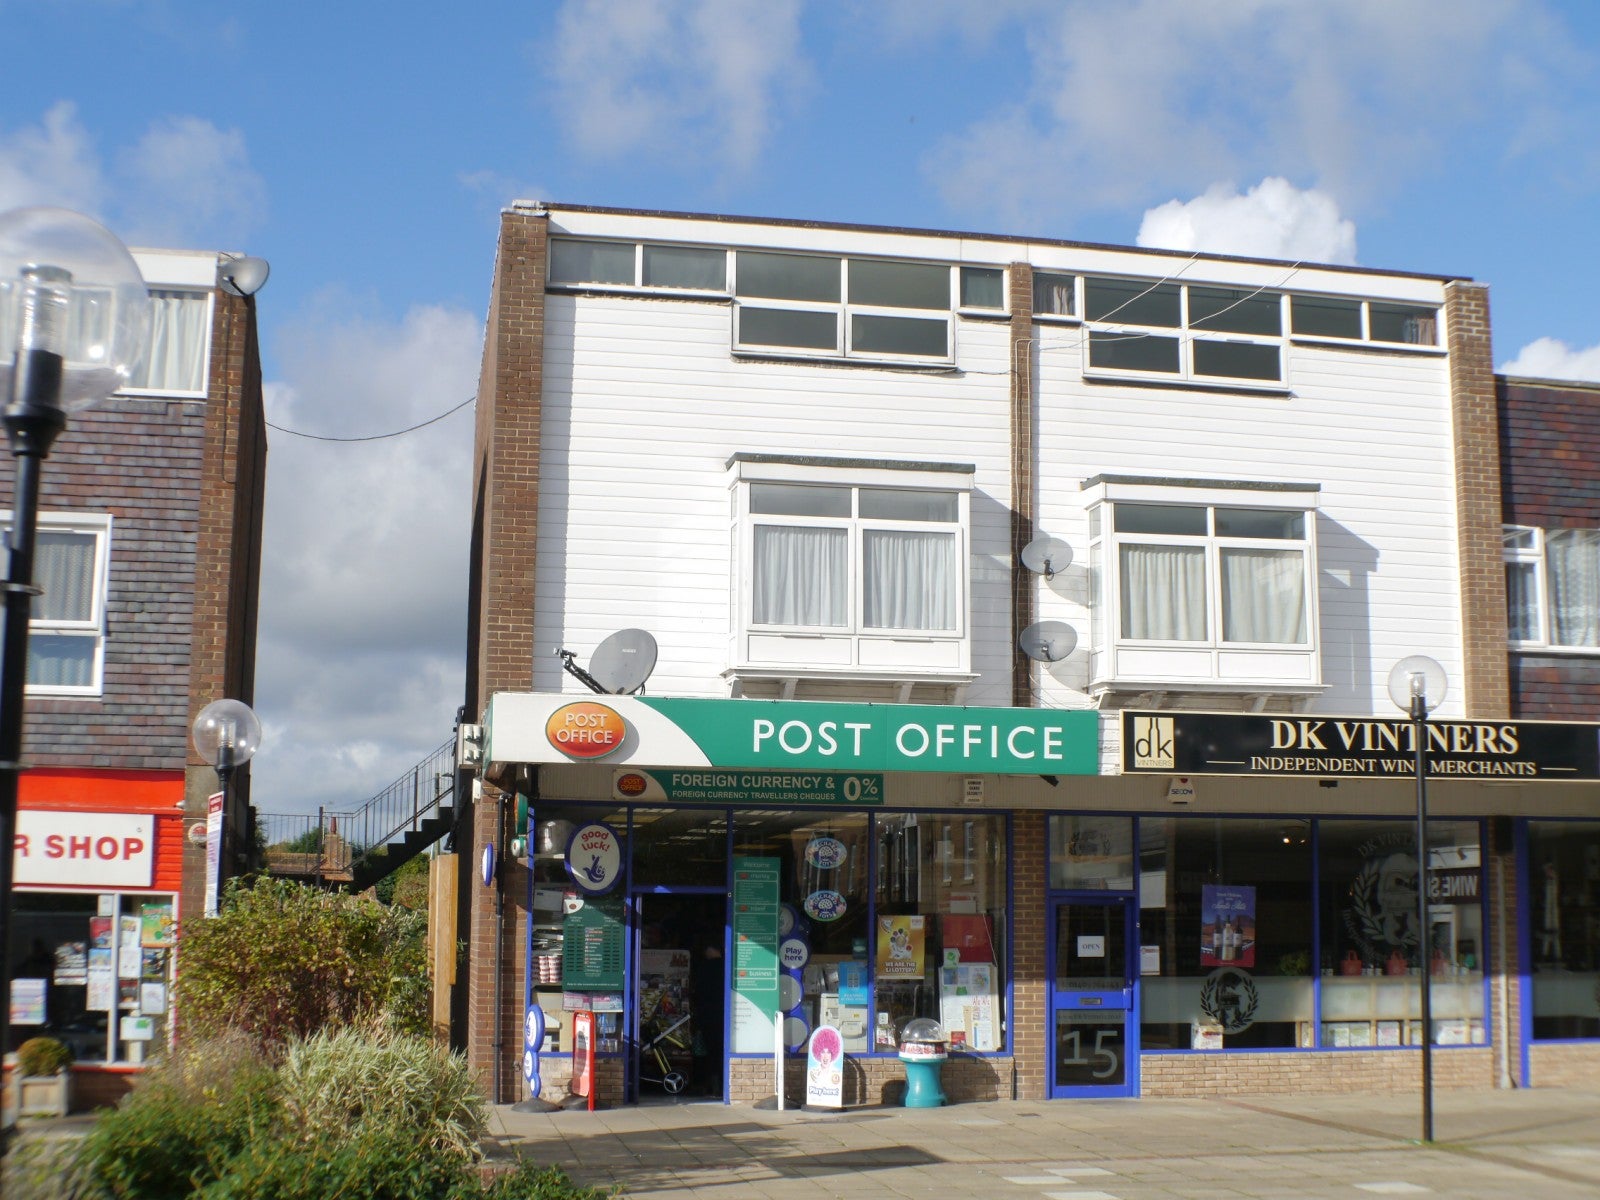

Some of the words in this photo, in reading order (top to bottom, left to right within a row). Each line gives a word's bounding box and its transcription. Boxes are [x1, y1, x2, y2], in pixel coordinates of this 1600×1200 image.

[565, 713, 608, 728] POST
[556, 728, 613, 744] OFFICE
[752, 719, 871, 757] POST
[896, 722, 1064, 760] OFFICE
[1269, 719, 1328, 750] DK
[1334, 721, 1520, 755] VINTNERS
[1136, 759, 1173, 767] VINTNERS
[1250, 755, 1377, 773] INDEPENDENT
[1379, 758, 1418, 774] WIN
[1430, 760, 1537, 776] MERCHANTS
[672, 773, 738, 788] FOREIGN
[741, 774, 821, 790] CURRENCY
[825, 776, 835, 790] &
[843, 776, 879, 802] 0%
[672, 790, 706, 799] FOREIGN
[707, 791, 749, 800] CURRENCY
[750, 792, 799, 800] TRAVELLERS
[799, 792, 836, 801] CHEQUES
[581, 830, 610, 842] good
[44, 833, 144, 861] SHOP
[784, 954, 803, 962] here
[785, 947, 802, 956] Play
[1062, 1030, 1119, 1079] 15
